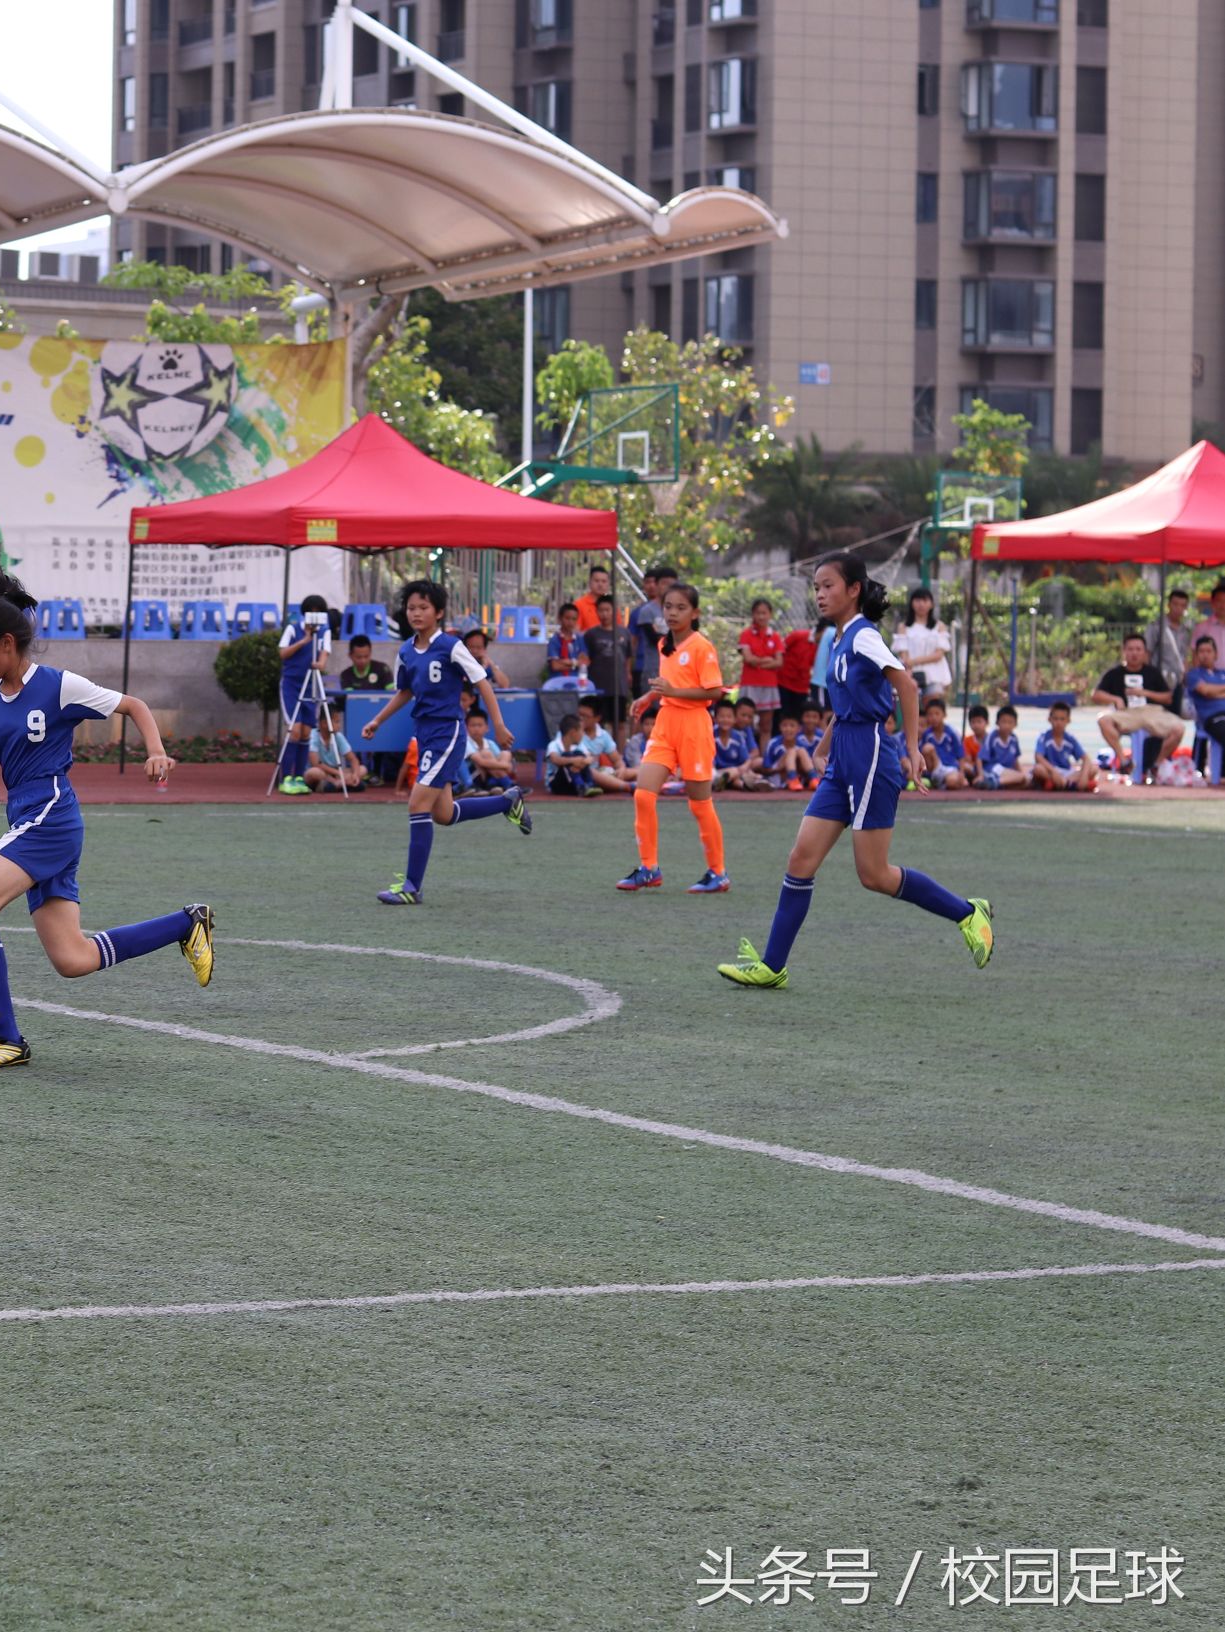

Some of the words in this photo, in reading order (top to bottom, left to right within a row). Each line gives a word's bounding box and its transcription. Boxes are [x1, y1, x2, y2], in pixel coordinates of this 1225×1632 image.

[146, 370, 192, 382] KELME
[429, 660, 442, 683] 6
[834, 653, 848, 683] 11
[27, 709, 46, 743] 9
[420, 750, 433, 772] 6
